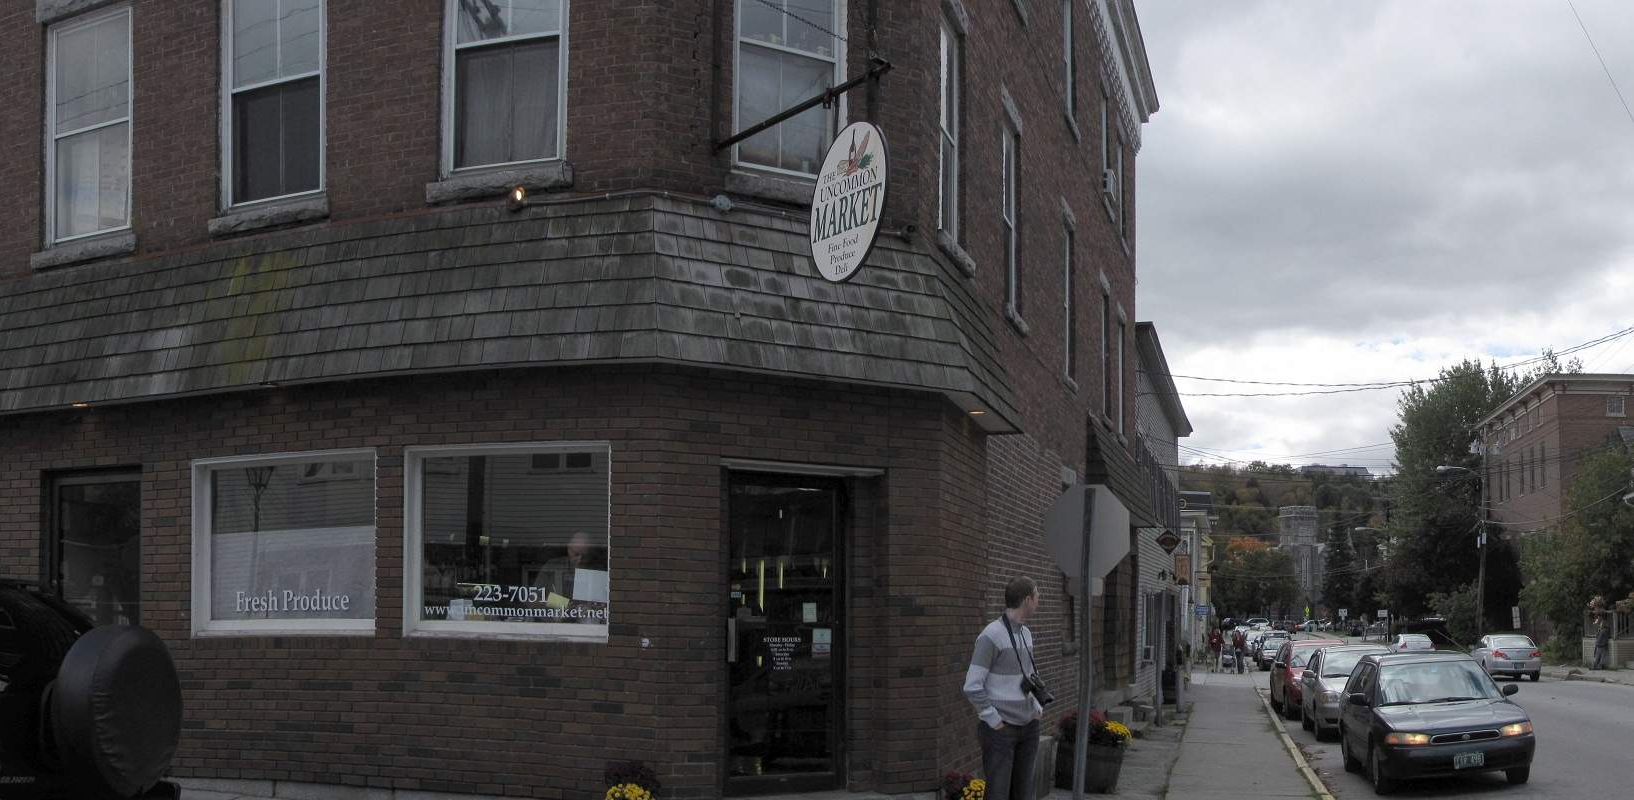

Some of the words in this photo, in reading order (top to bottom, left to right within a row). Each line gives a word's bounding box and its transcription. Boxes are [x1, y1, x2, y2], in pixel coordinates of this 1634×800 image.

[820, 166, 878, 202] UNCOMMON
[823, 171, 836, 184] THE
[813, 183, 882, 244] MARKET
[828, 240, 841, 254] Fine
[842, 233, 859, 250] Food
[830, 250, 856, 265] Produce
[835, 263, 848, 275] Deli
[236, 590, 278, 611] Fresh
[283, 589, 350, 611] Produce
[473, 585, 548, 603] 223-7051
